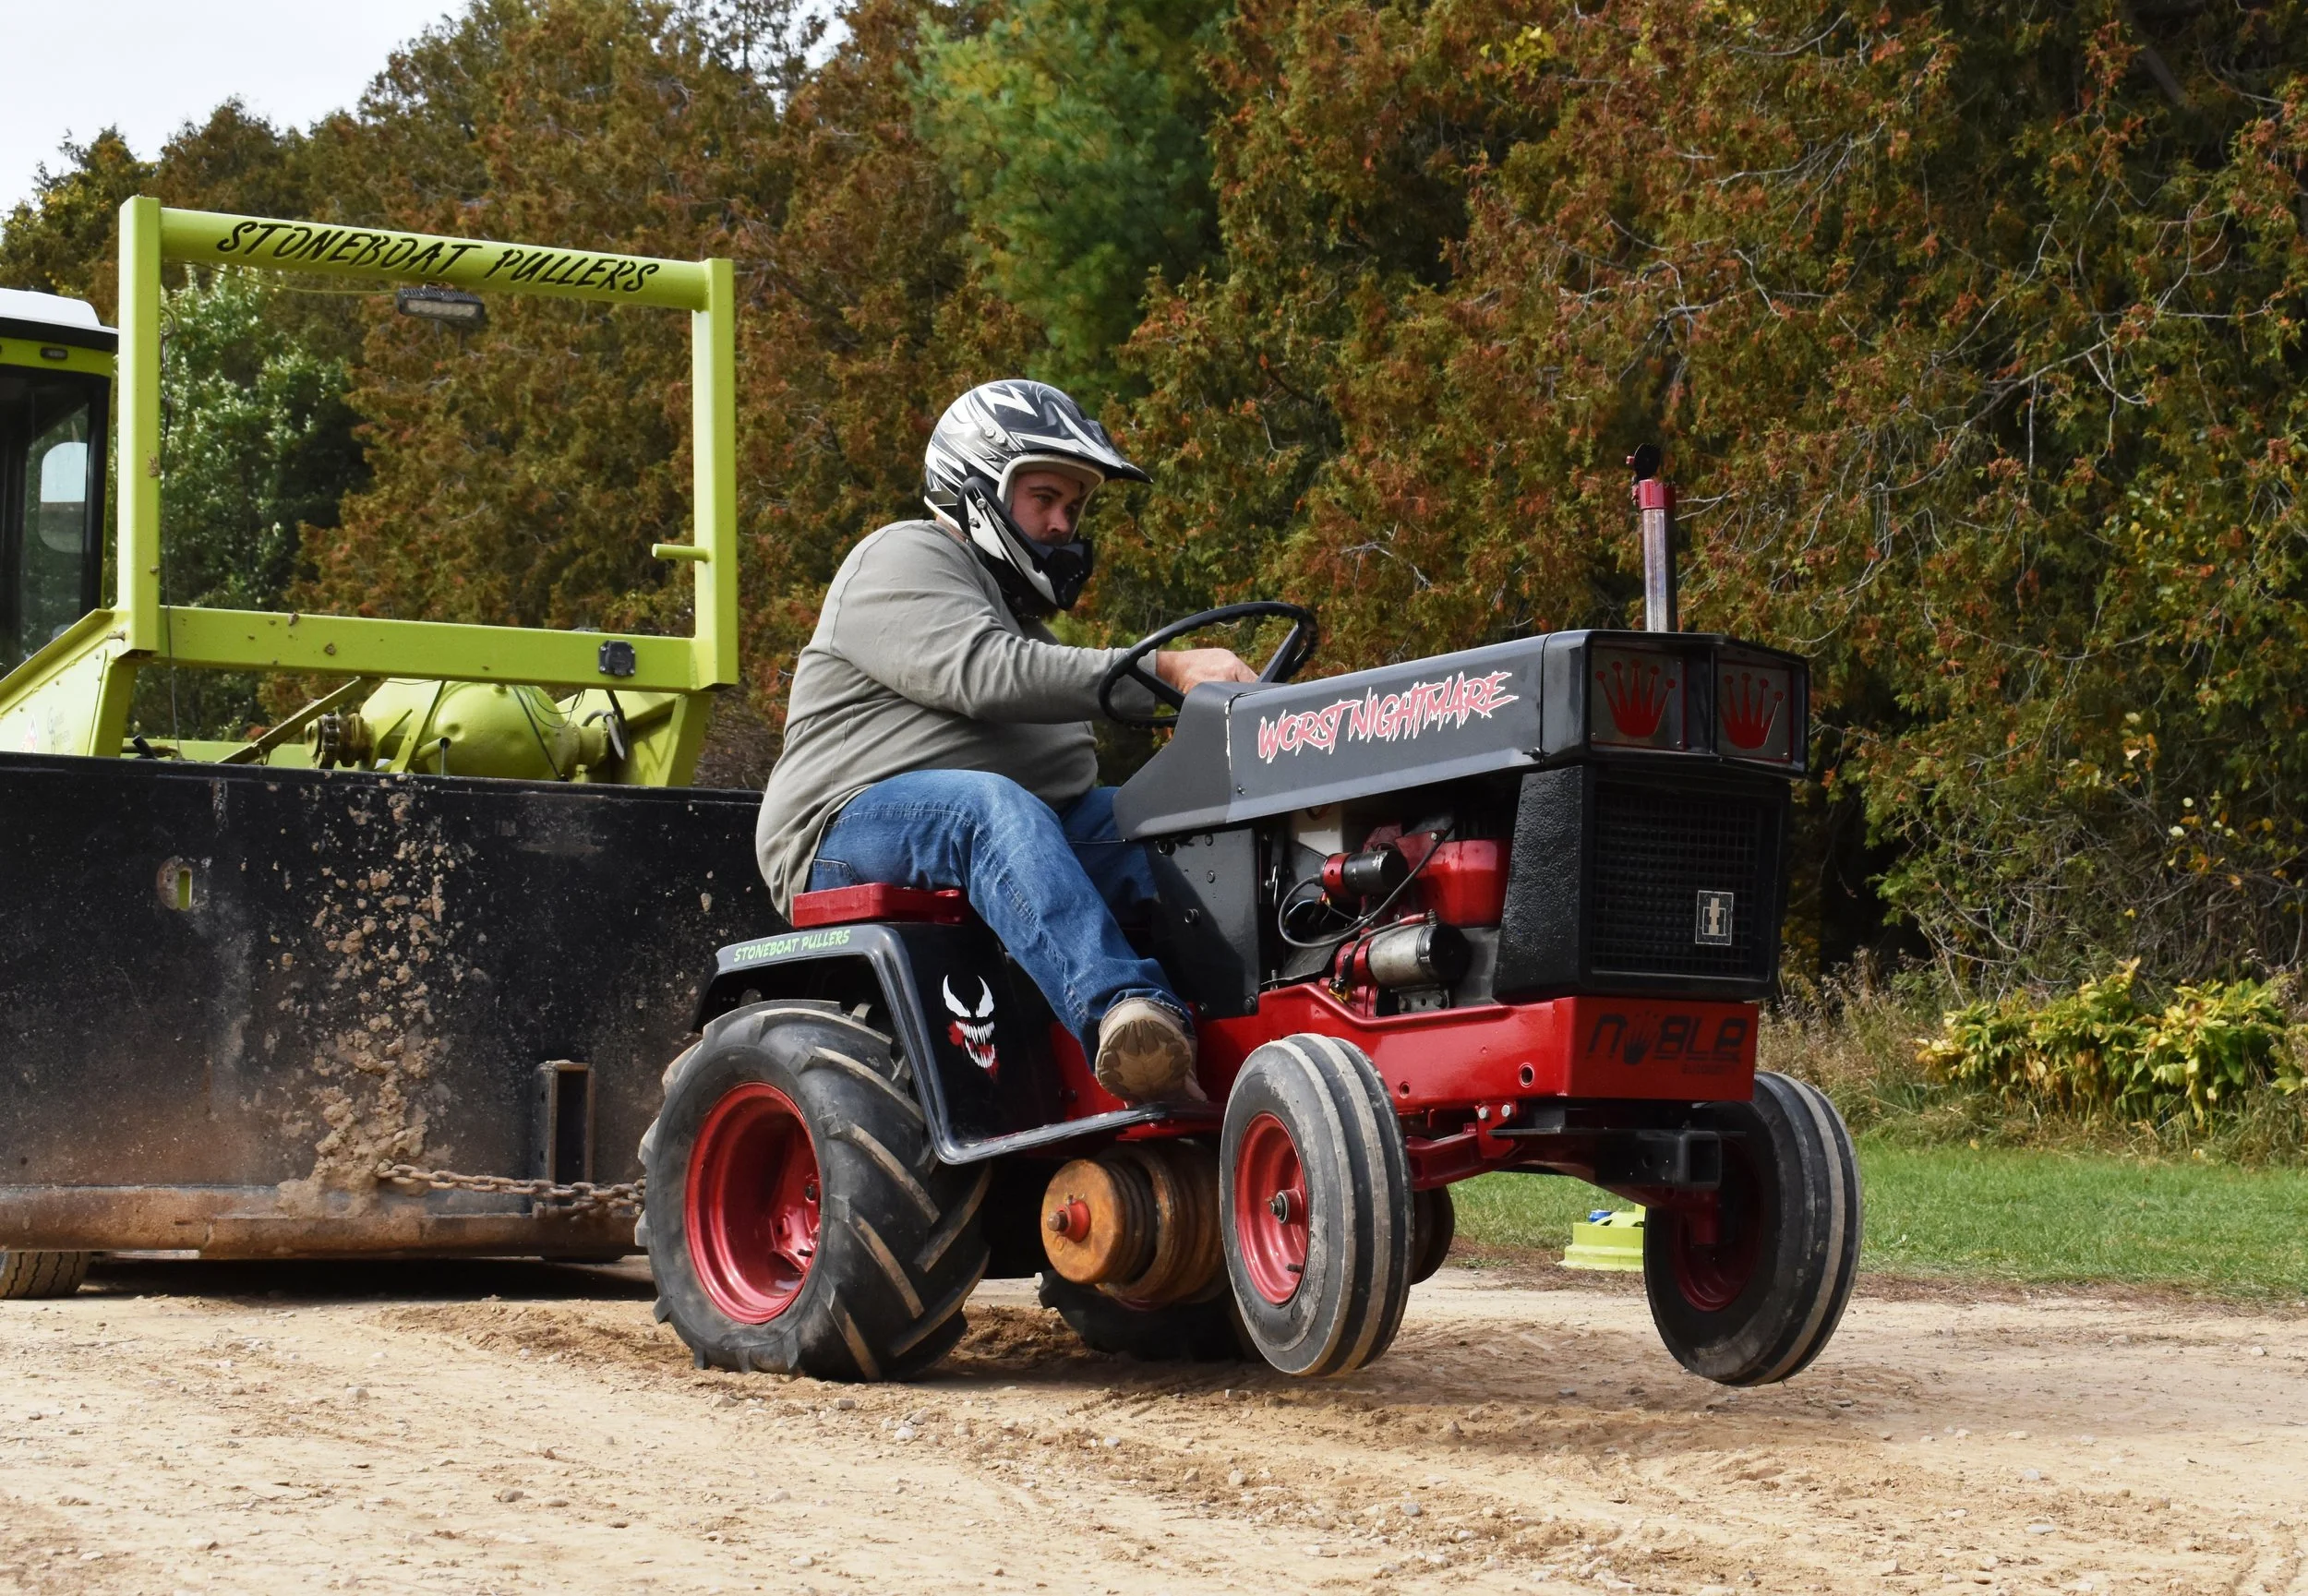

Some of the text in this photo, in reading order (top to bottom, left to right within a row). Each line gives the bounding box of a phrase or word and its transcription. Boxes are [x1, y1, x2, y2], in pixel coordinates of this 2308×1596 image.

[217, 221, 660, 293] STONEBOAT PULLERS
[1258, 671, 1519, 763] WORST NIGHTMARE
[733, 929, 851, 963] STONEBOAT PULLERS
